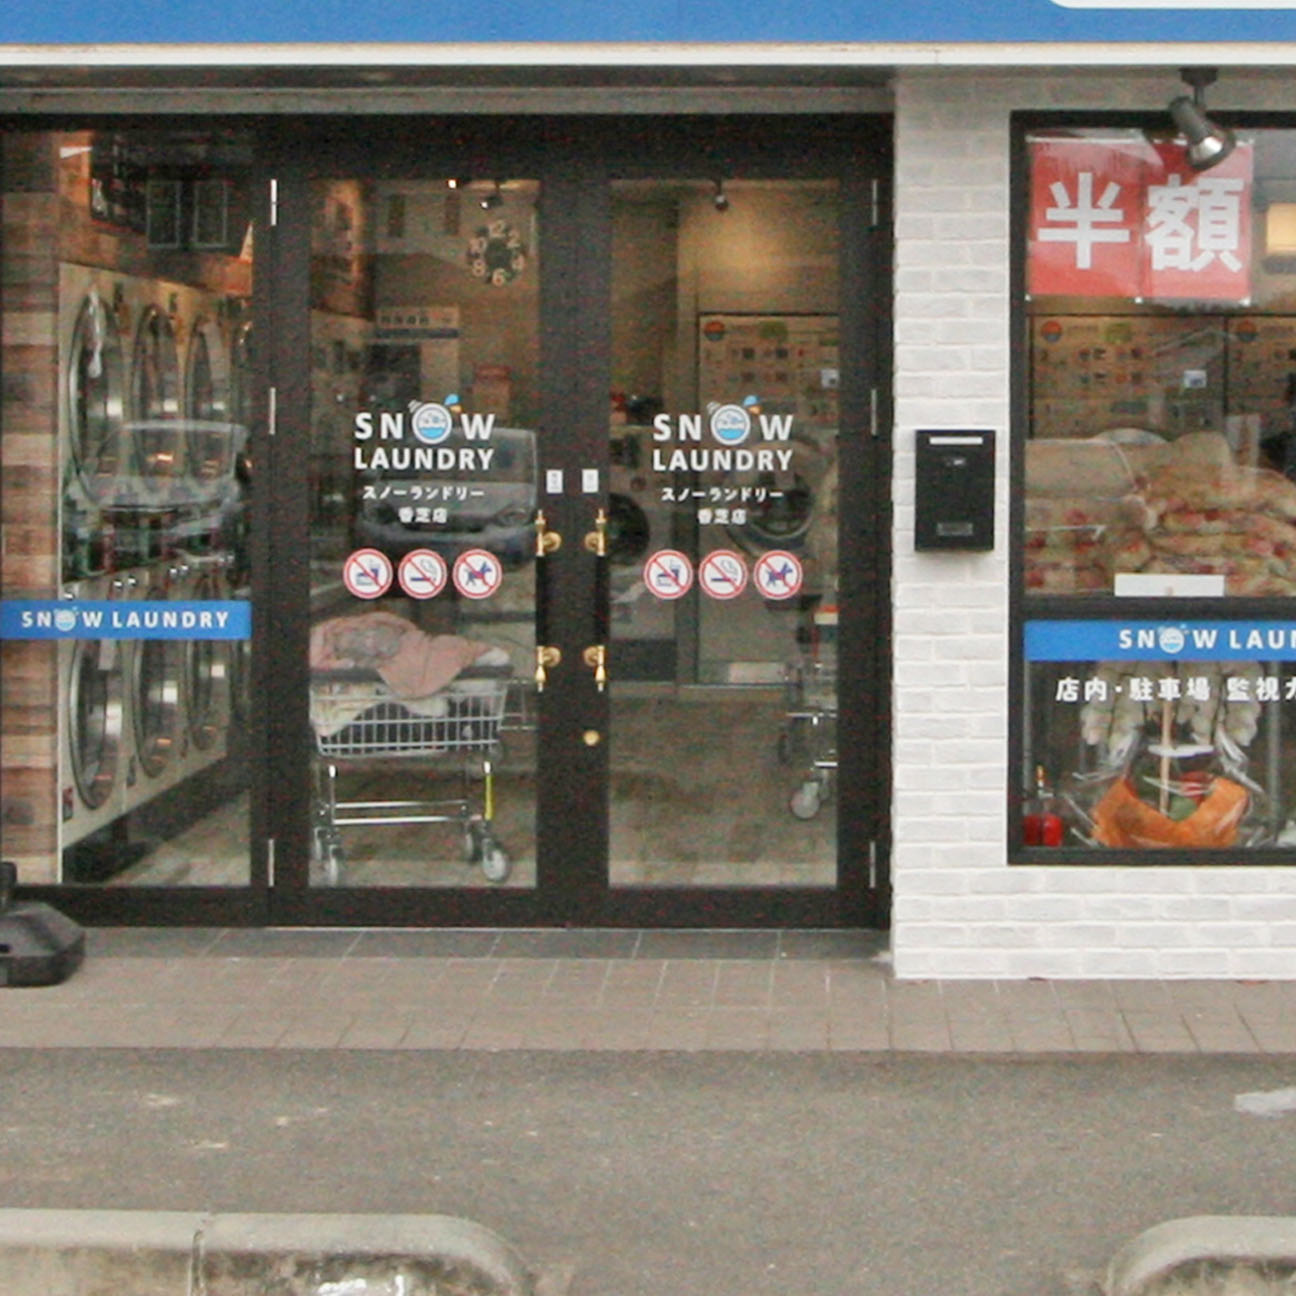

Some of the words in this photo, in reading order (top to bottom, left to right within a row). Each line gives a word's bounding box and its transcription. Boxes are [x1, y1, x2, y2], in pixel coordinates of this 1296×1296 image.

[354, 447, 495, 471] LAUNDRY
[652, 448, 793, 472] LAUNDRY
[362, 485, 485, 501] スノーランドリー
[660, 487, 784, 503] スノーランドリー
[112, 611, 230, 629] LAUNDRY
